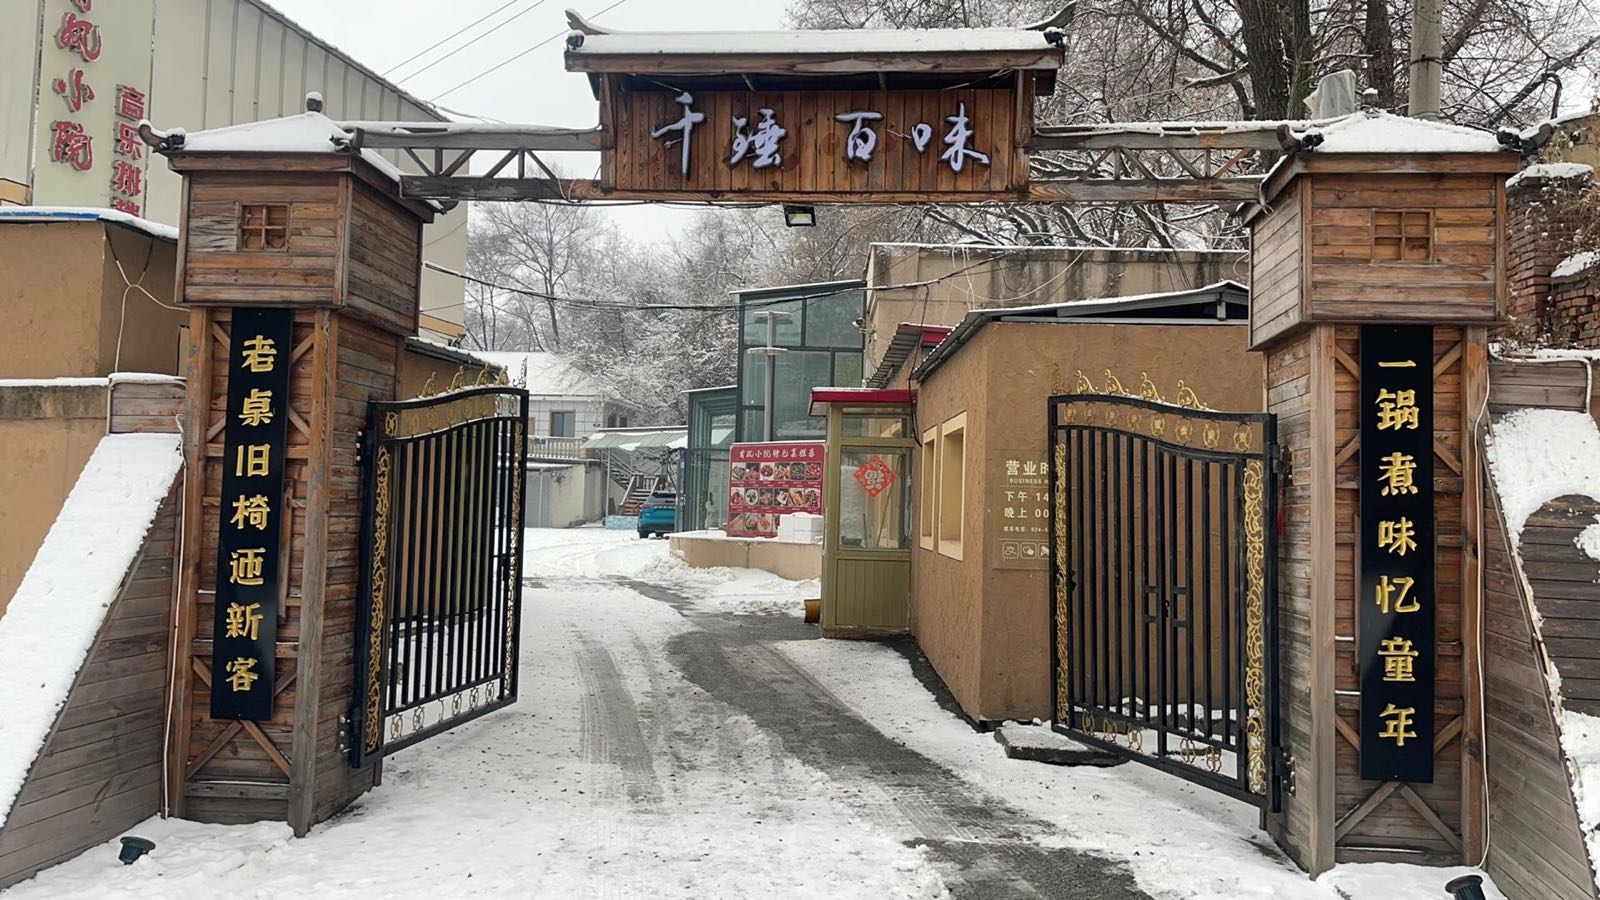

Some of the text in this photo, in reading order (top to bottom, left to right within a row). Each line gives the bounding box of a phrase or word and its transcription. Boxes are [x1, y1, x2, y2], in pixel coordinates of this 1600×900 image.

[1004, 490, 1028, 503] 下午
[1004, 506, 1028, 519] 晚上
[1374, 359, 1421, 747] 一锅煮味忆童年
